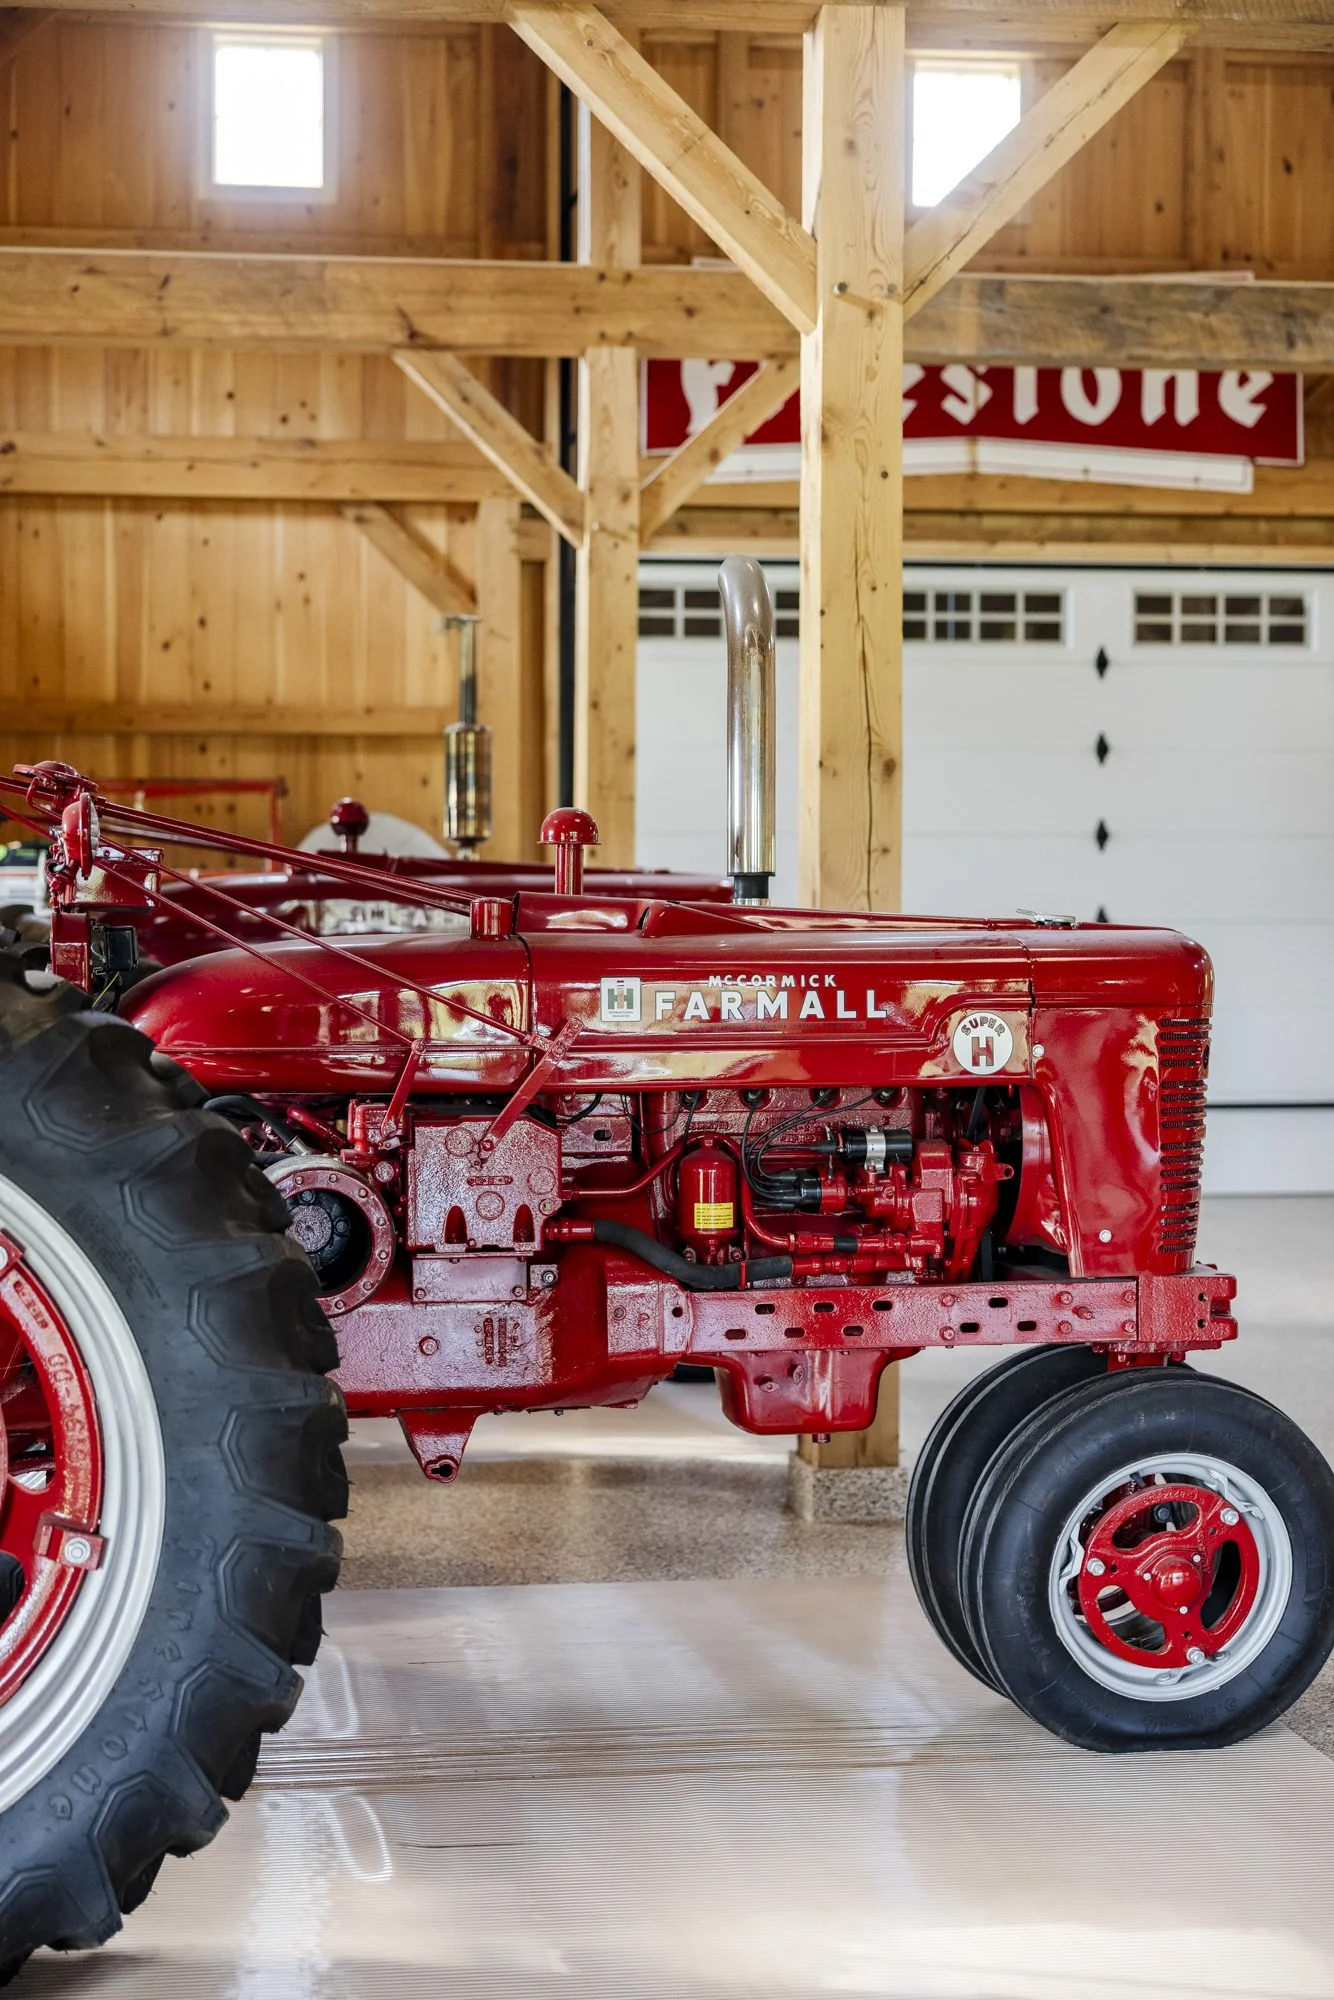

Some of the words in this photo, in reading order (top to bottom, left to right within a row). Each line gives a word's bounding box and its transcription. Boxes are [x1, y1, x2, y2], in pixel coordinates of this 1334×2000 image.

[655, 990, 888, 1021] FARMALL
[960, 1015, 1006, 1038] SUPER
[971, 1037, 995, 1067] H
